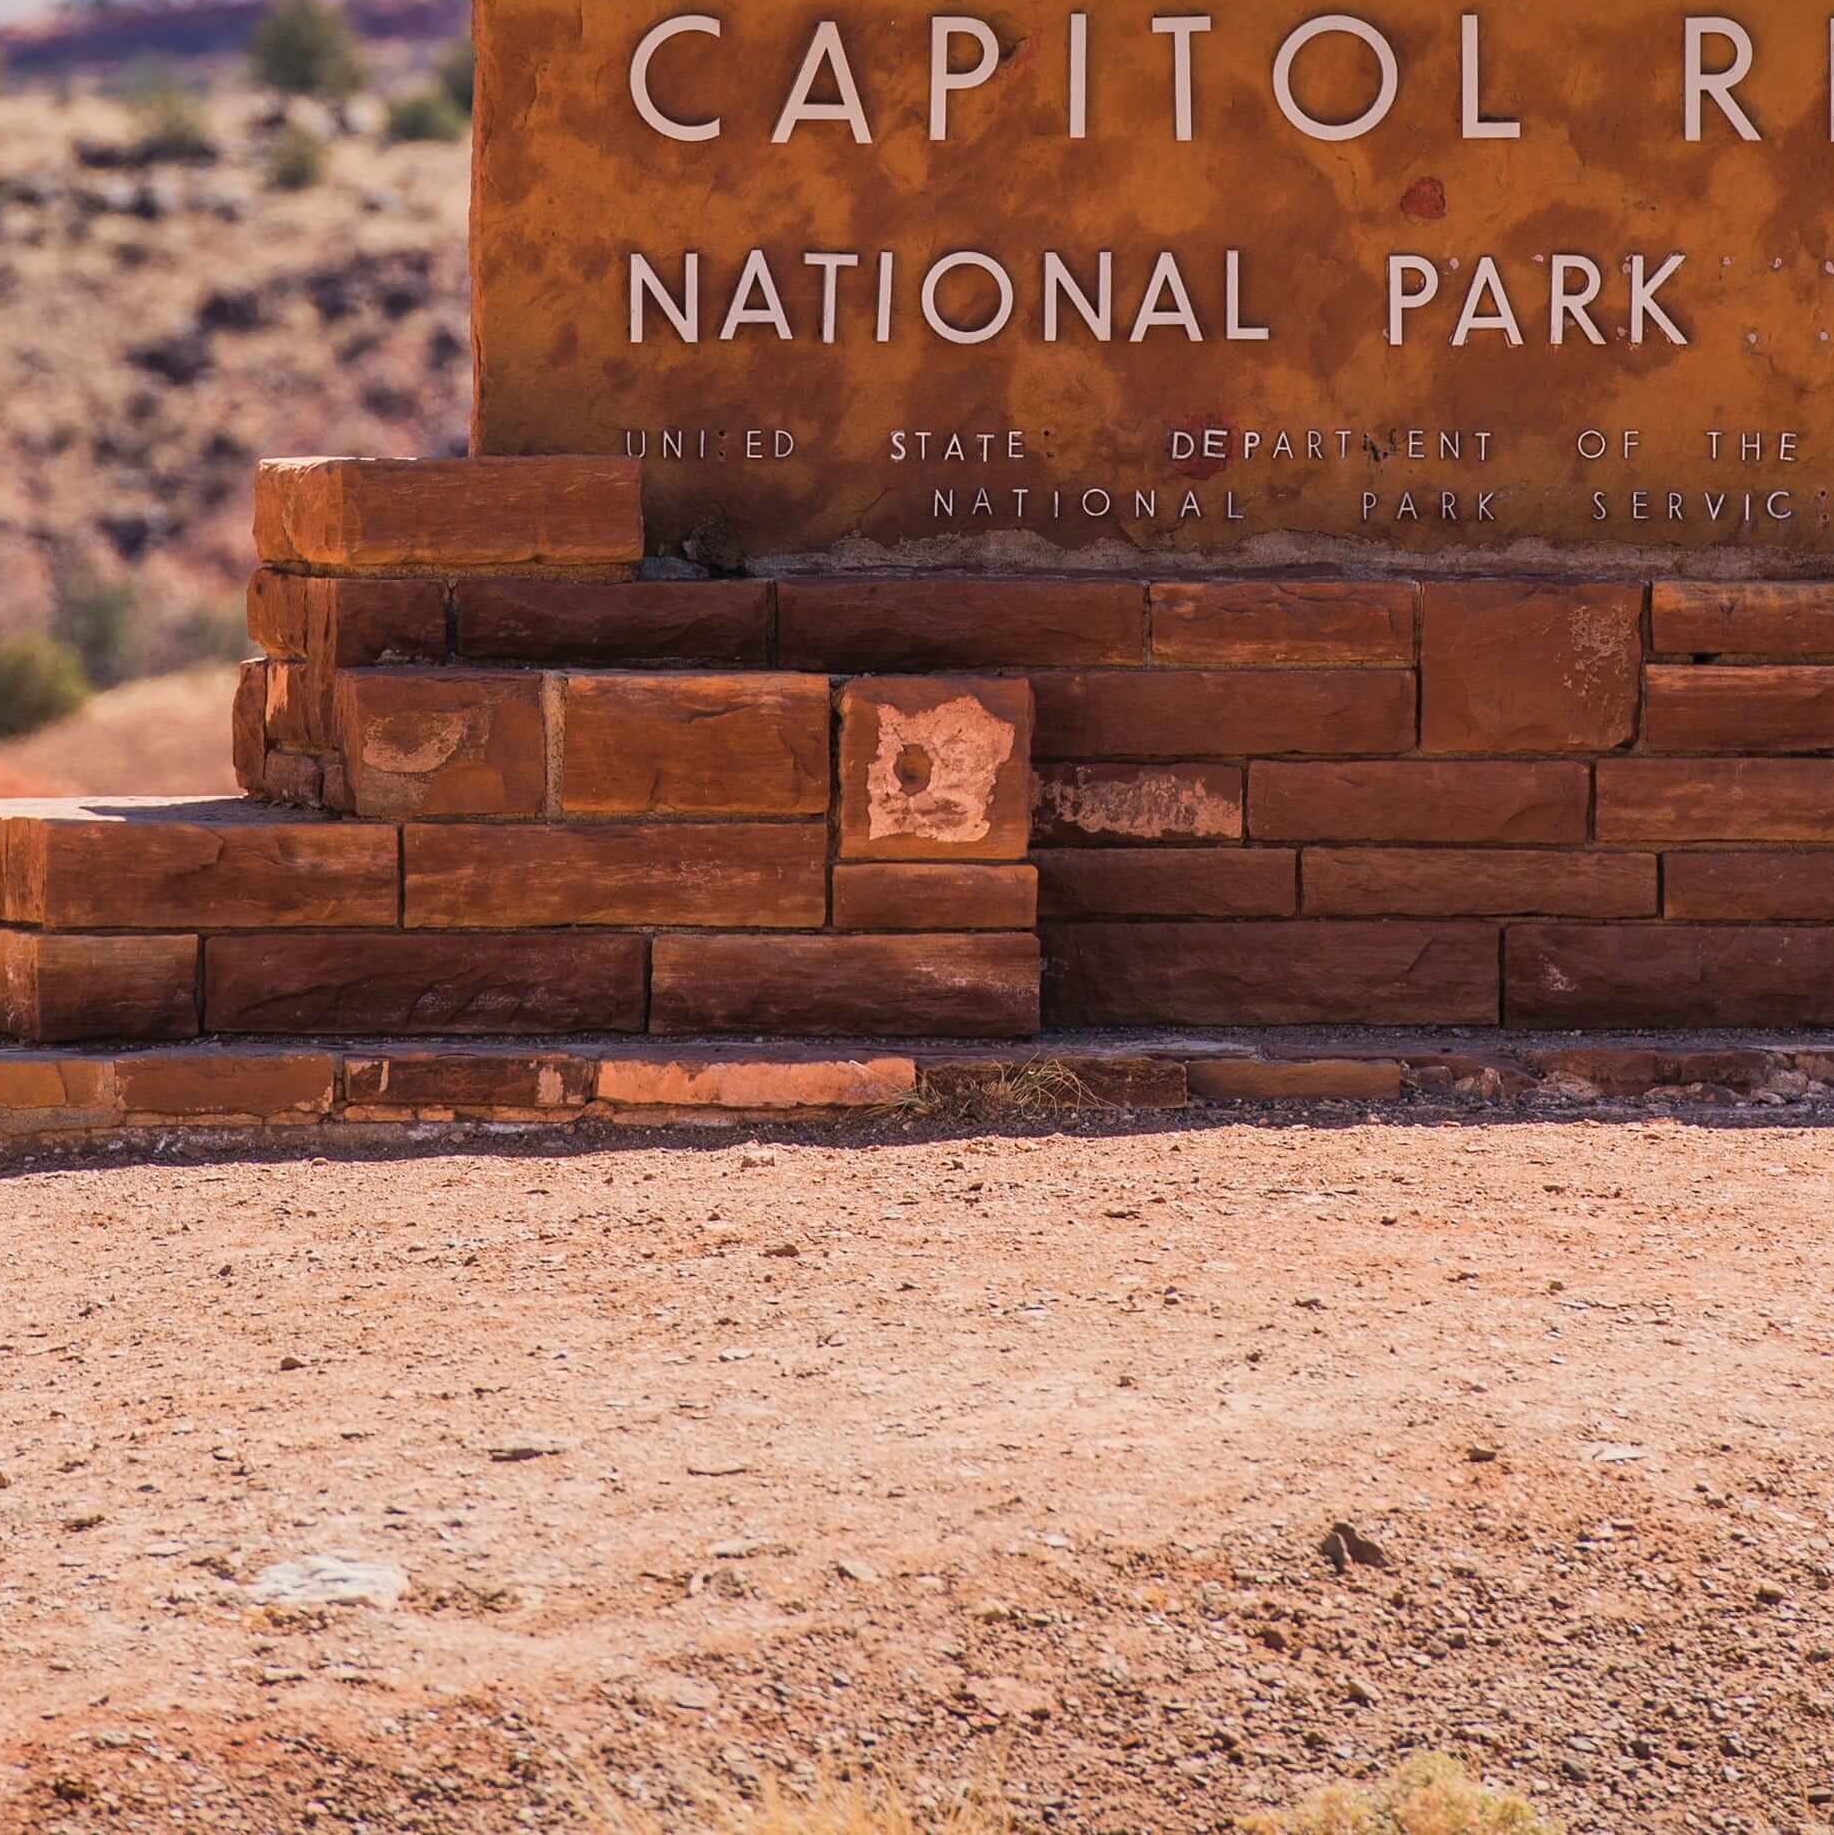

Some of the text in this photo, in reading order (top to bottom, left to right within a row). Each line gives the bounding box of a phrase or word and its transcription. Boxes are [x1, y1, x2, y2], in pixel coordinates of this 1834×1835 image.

[629, 13, 1521, 145] CAPITOL
[628, 249, 1689, 347] NATIONAL PARK
[624, 428, 795, 460] UNIED
[1171, 428, 1493, 462] DEPARTENT
[1577, 429, 1641, 460] OF
[1706, 430, 1799, 462] THE
[933, 487, 1244, 520] NATIONAL
[1361, 490, 1496, 521] PARK
